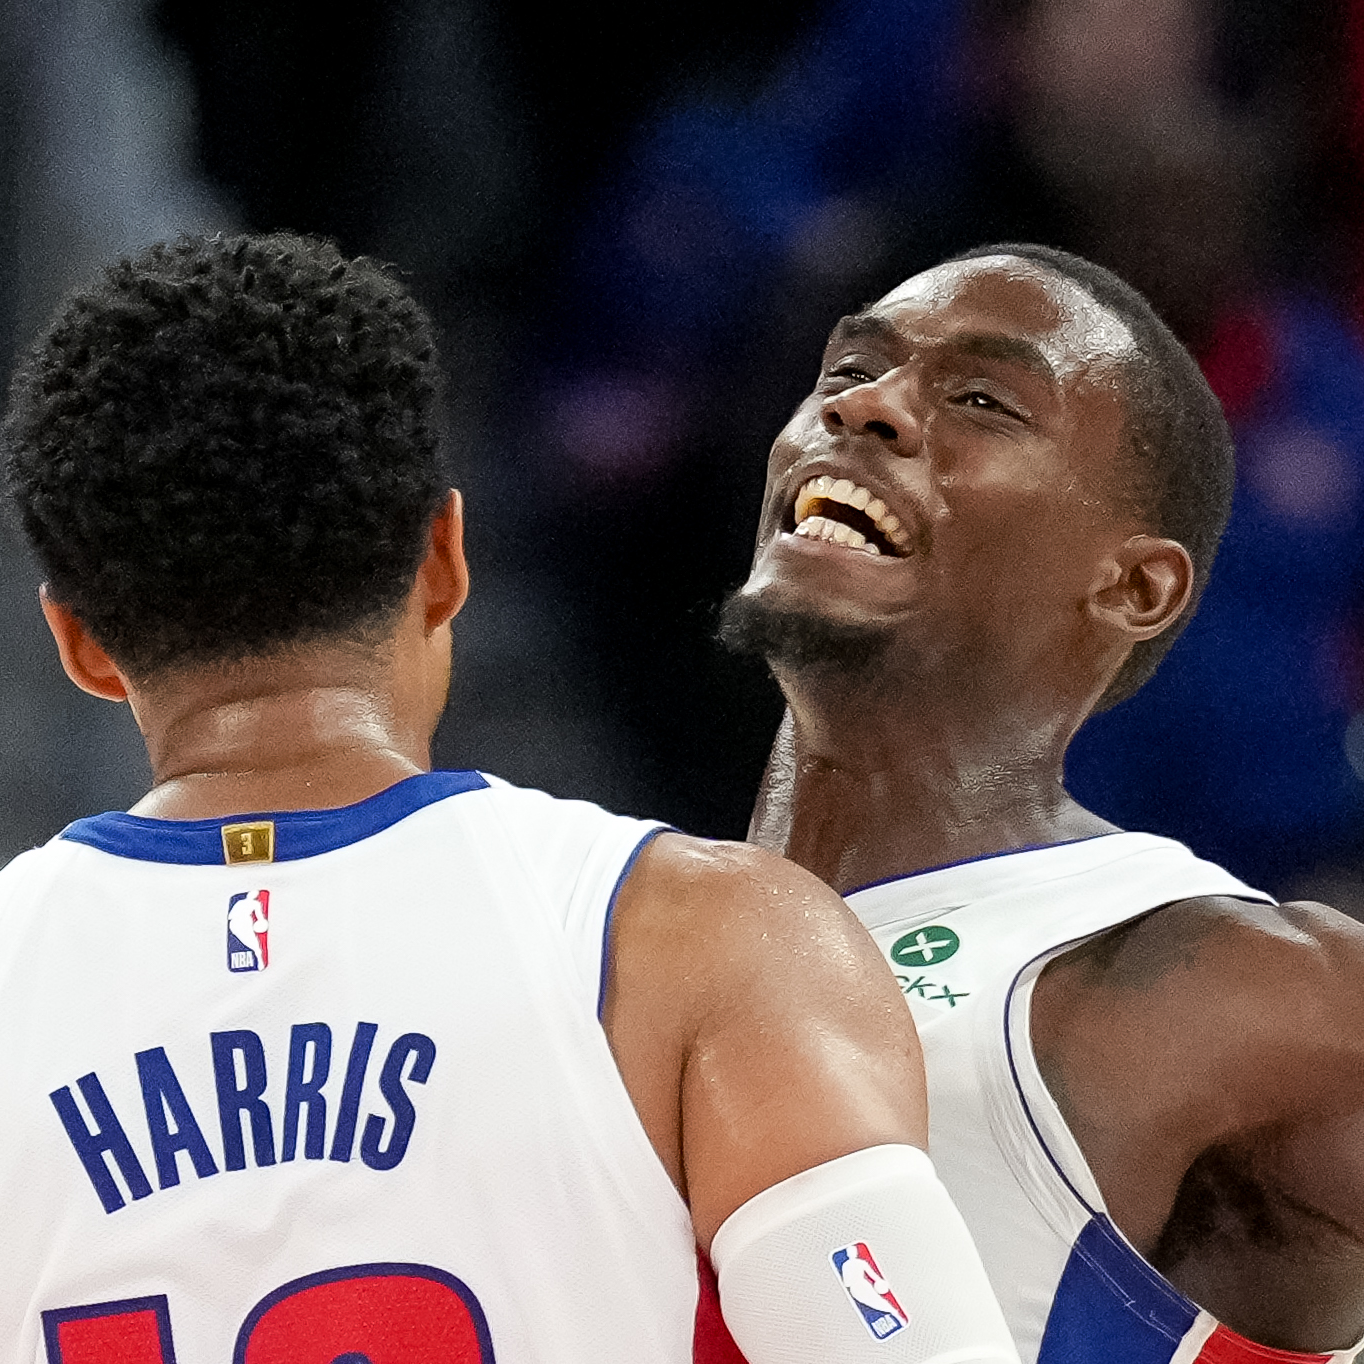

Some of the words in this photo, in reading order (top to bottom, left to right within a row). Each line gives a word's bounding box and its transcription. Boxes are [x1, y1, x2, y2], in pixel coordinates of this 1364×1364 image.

[240, 832, 253, 855] 3
[230, 950, 254, 969] NBA
[50, 1021, 436, 1213] HARRIS
